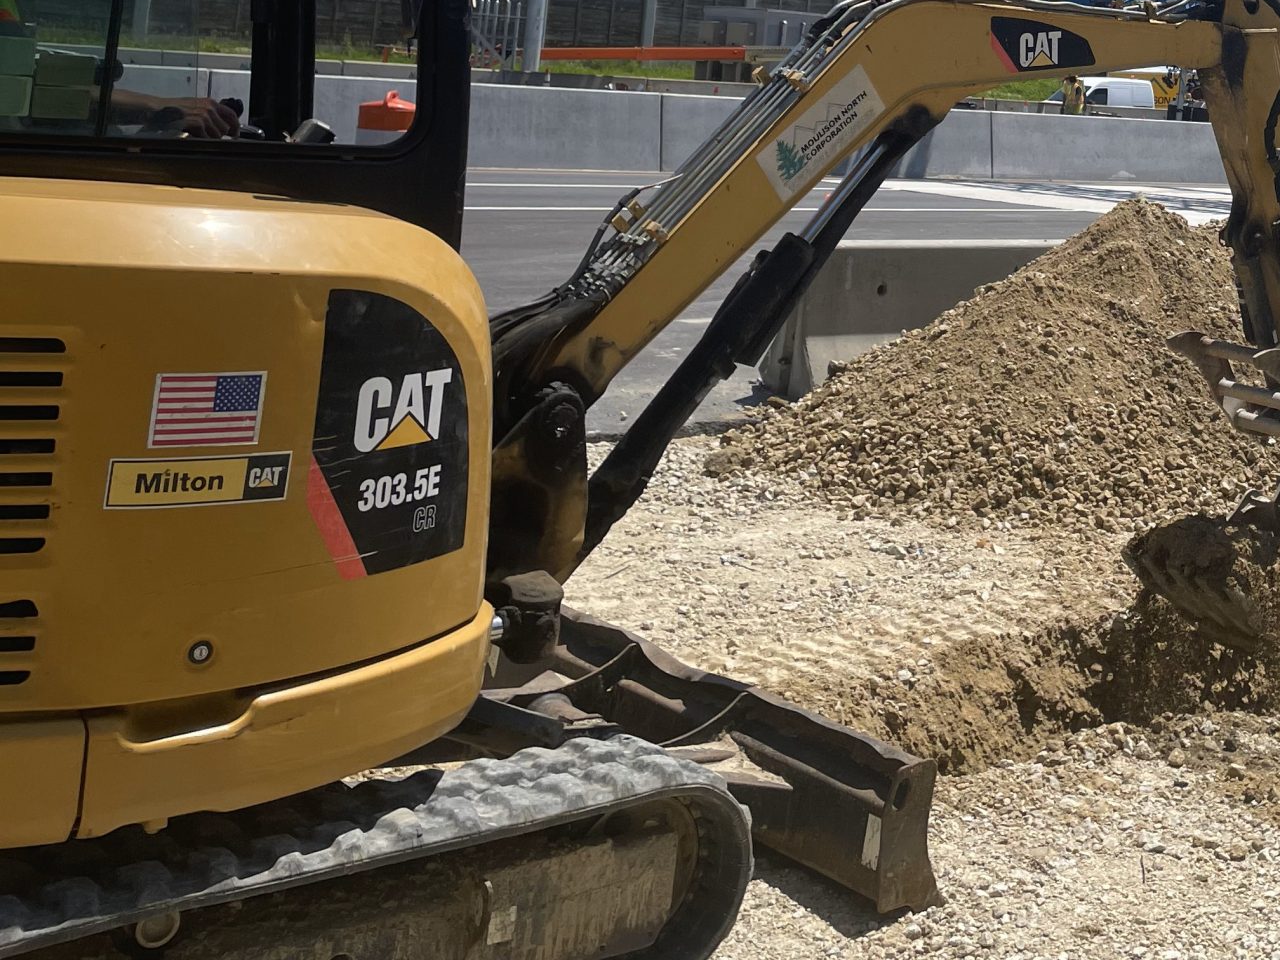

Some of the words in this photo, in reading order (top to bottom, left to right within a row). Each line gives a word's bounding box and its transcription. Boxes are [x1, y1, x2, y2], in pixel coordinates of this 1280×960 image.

[1020, 31, 1062, 67] CAT
[800, 114, 842, 154] MOULISON
[841, 90, 868, 118] NORTH
[805, 110, 858, 161] CORPORATION
[353, 367, 453, 453] CAT
[134, 468, 224, 494] Milton
[248, 466, 283, 488] CAT
[357, 464, 442, 512] 303.5E
[412, 504, 437, 533] CR
